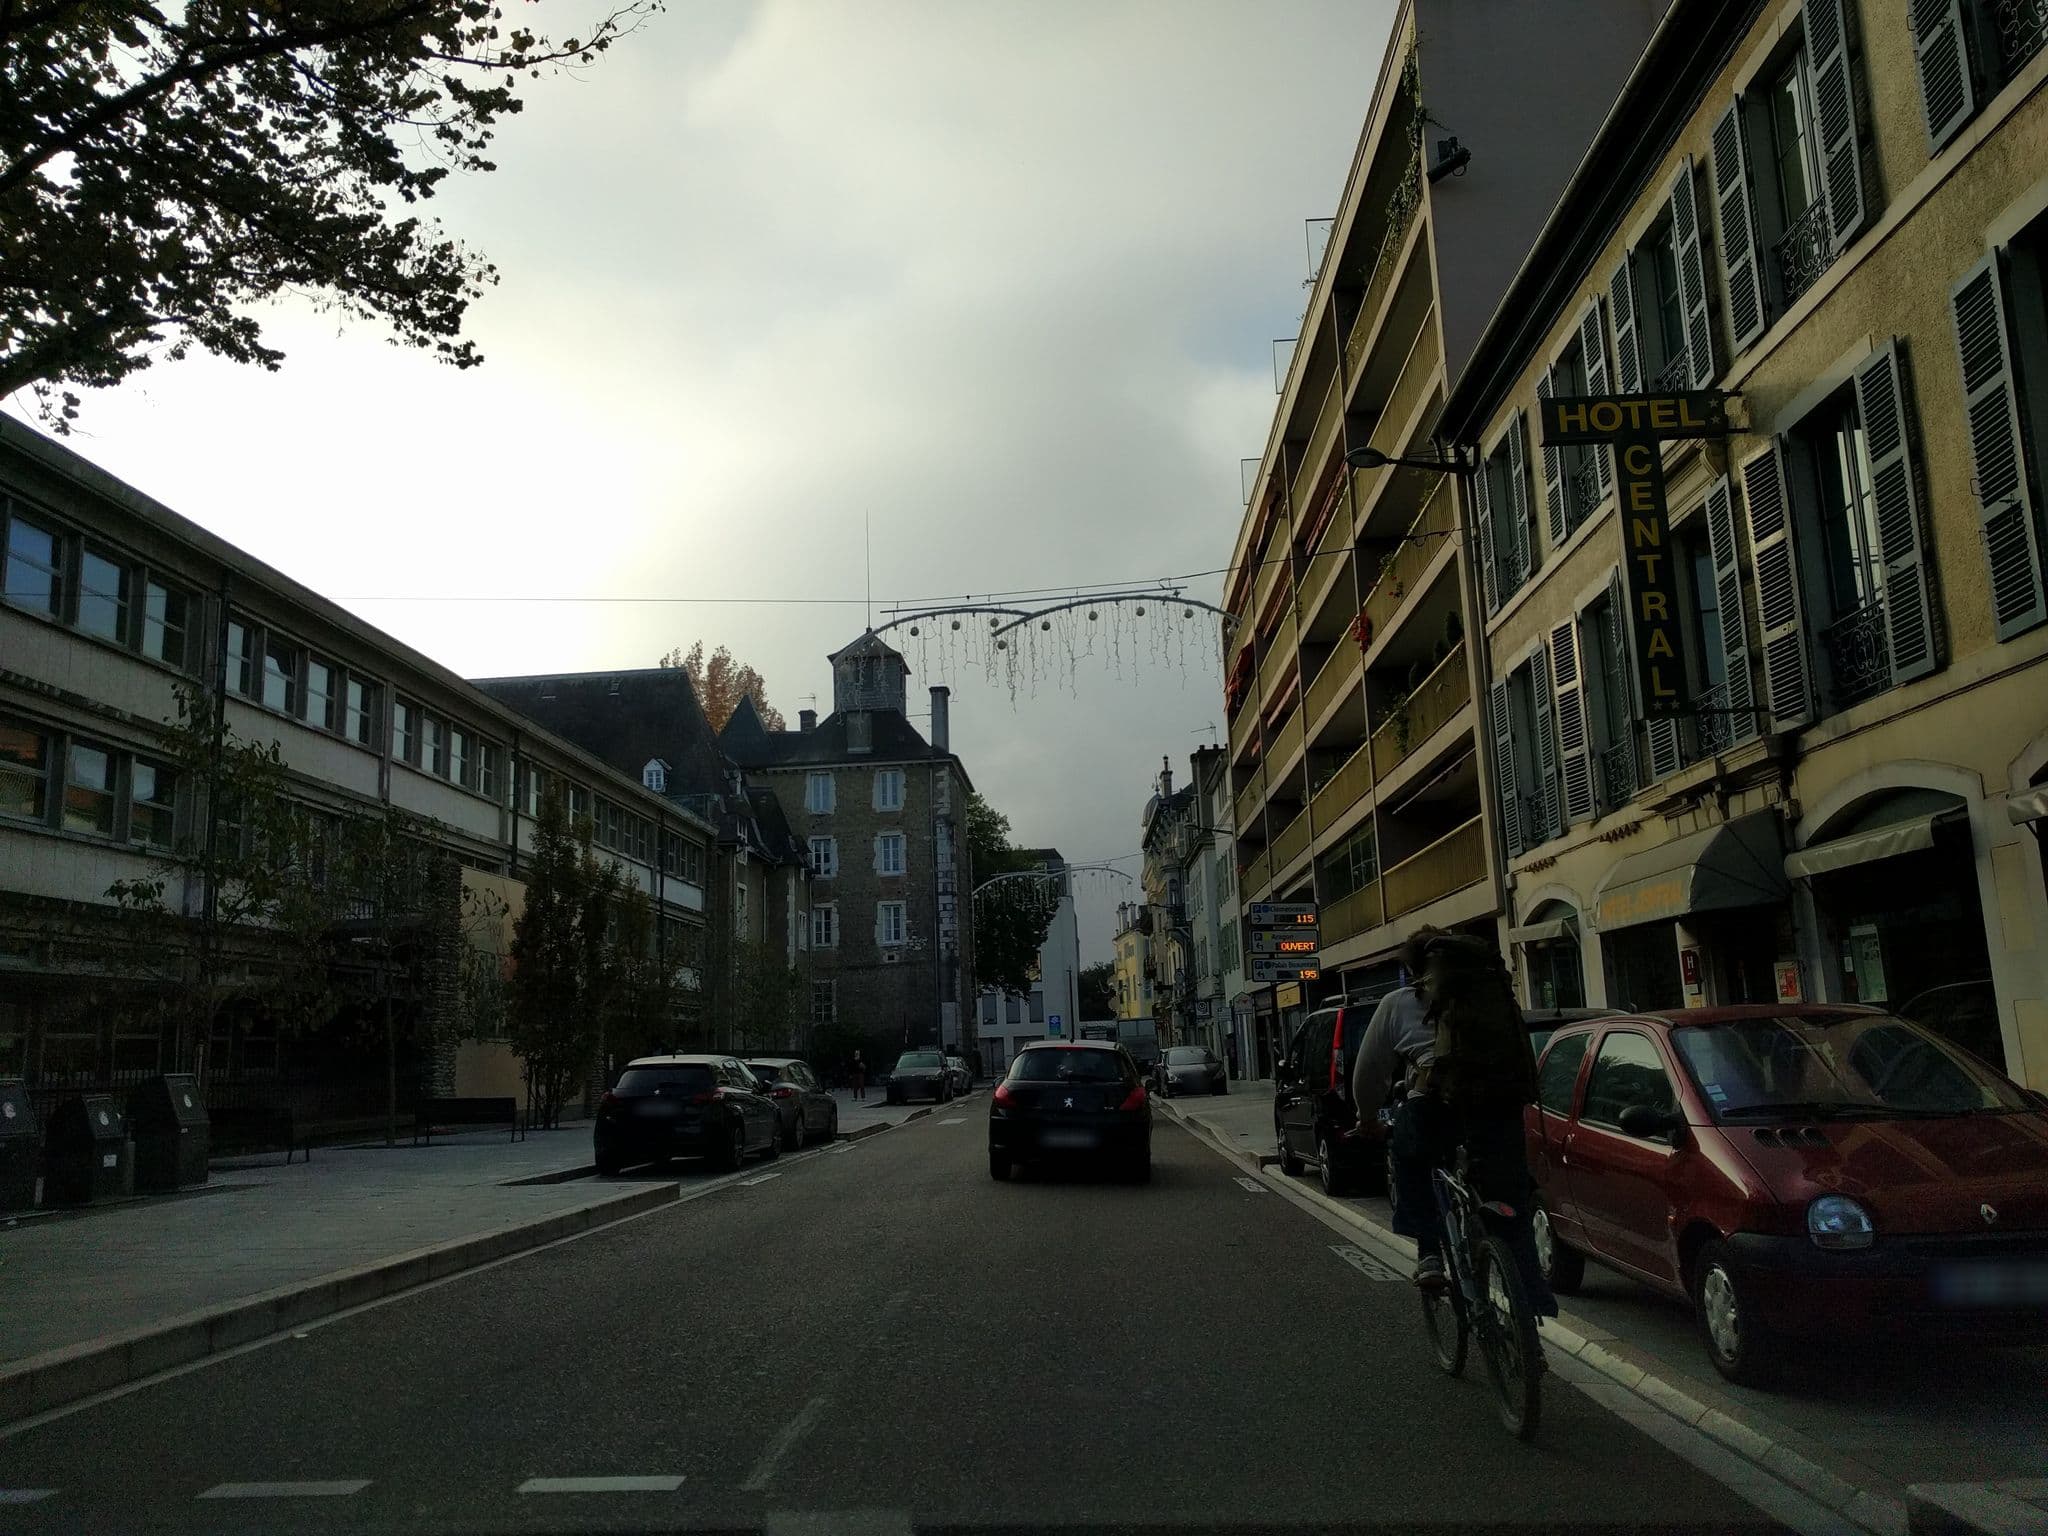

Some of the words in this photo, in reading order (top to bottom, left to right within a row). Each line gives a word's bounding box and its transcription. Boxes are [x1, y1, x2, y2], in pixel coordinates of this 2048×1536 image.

[1557, 398, 1706, 433] HOTEL
[1623, 444, 1677, 698] CENTRAL
[1296, 914, 1314, 923] 115
[1280, 942, 1315, 951] OUVERT
[1299, 970, 1317, 979] 195
